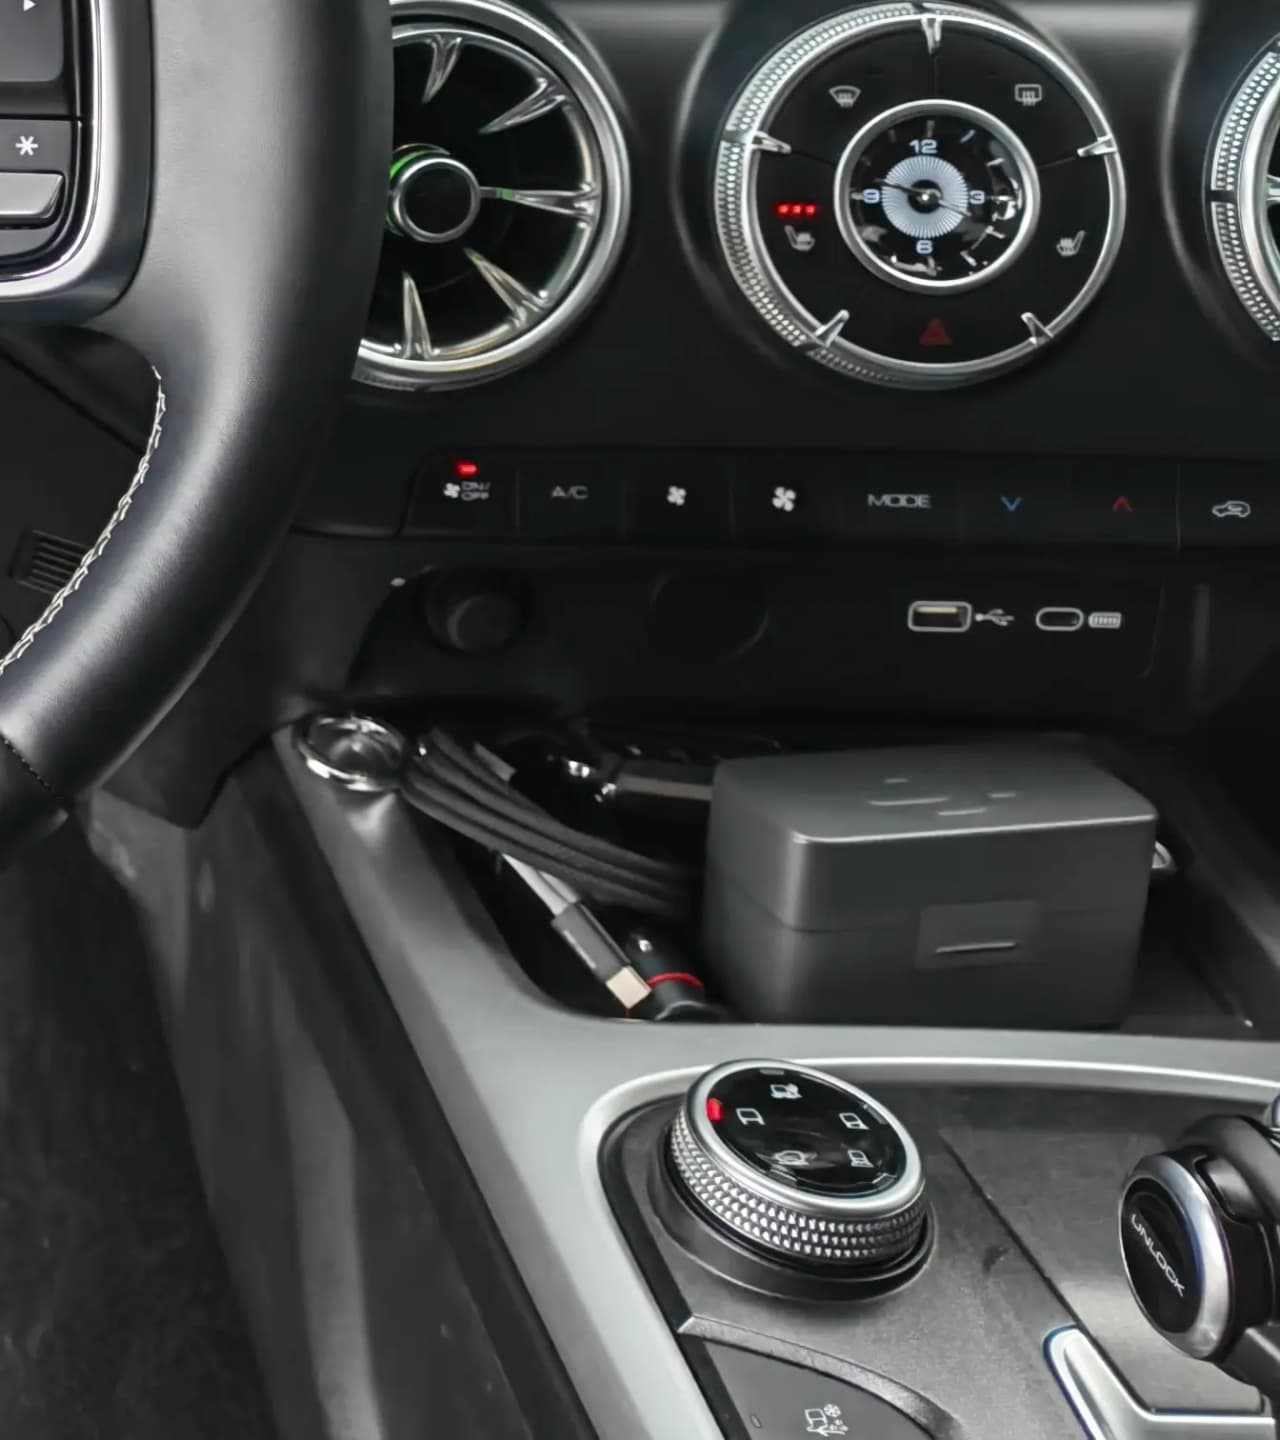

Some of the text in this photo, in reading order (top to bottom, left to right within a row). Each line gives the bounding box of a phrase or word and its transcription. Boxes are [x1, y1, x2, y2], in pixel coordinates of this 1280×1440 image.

[910, 139, 938, 154] 12
[865, 189, 880, 204] 9
[970, 189, 986, 204] 3
[916, 239, 933, 255] 6
[551, 485, 588, 499] A/C
[867, 493, 931, 508] MODE
[1130, 1213, 1185, 1297] UNLOCK
